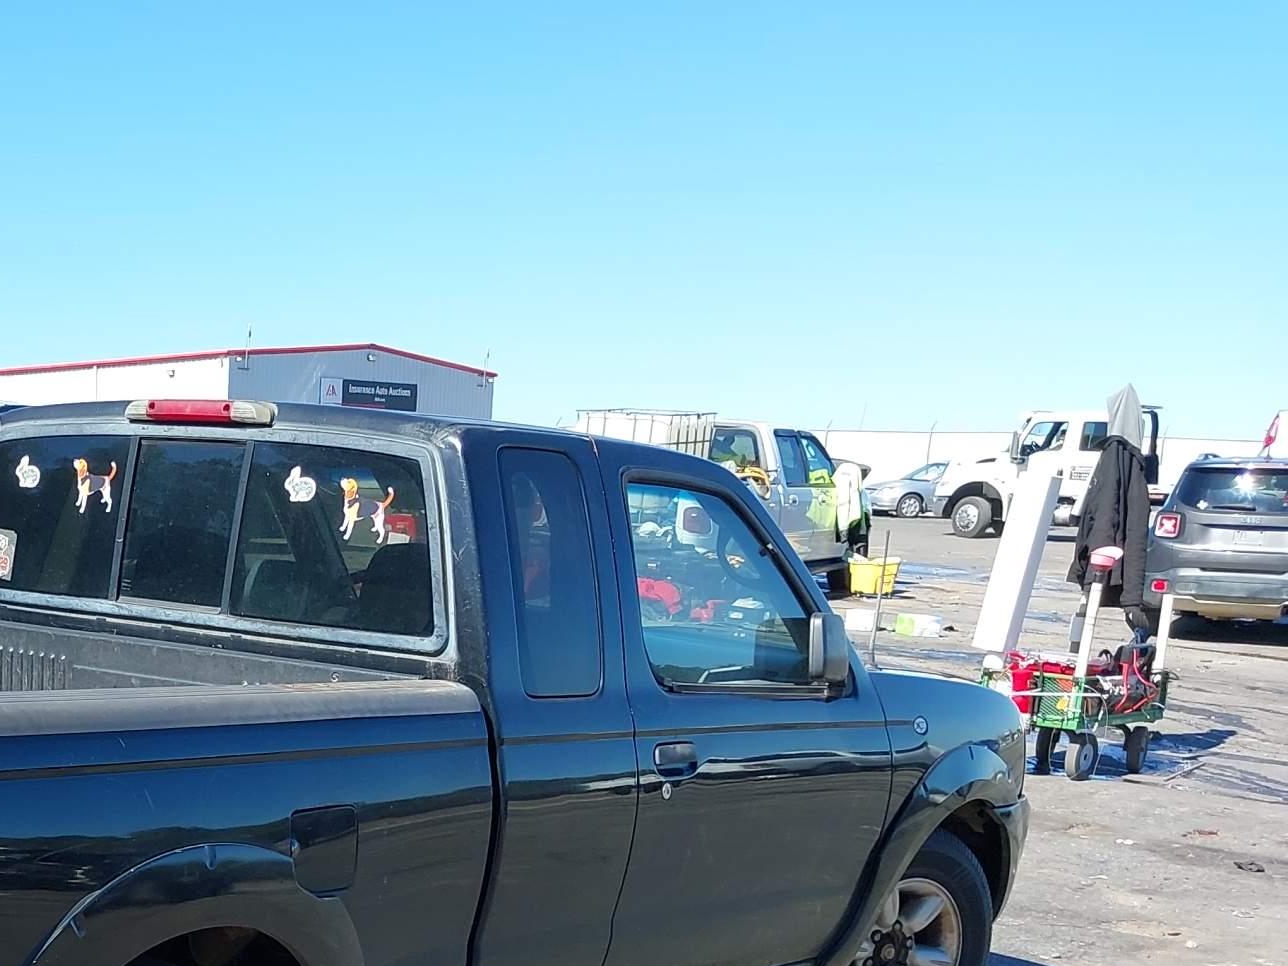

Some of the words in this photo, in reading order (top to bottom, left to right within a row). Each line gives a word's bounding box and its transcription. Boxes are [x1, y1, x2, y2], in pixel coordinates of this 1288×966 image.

[348, 384, 375, 395] Insurance
[375, 386, 388, 396] Auto
[388, 386, 411, 397] Auctions
